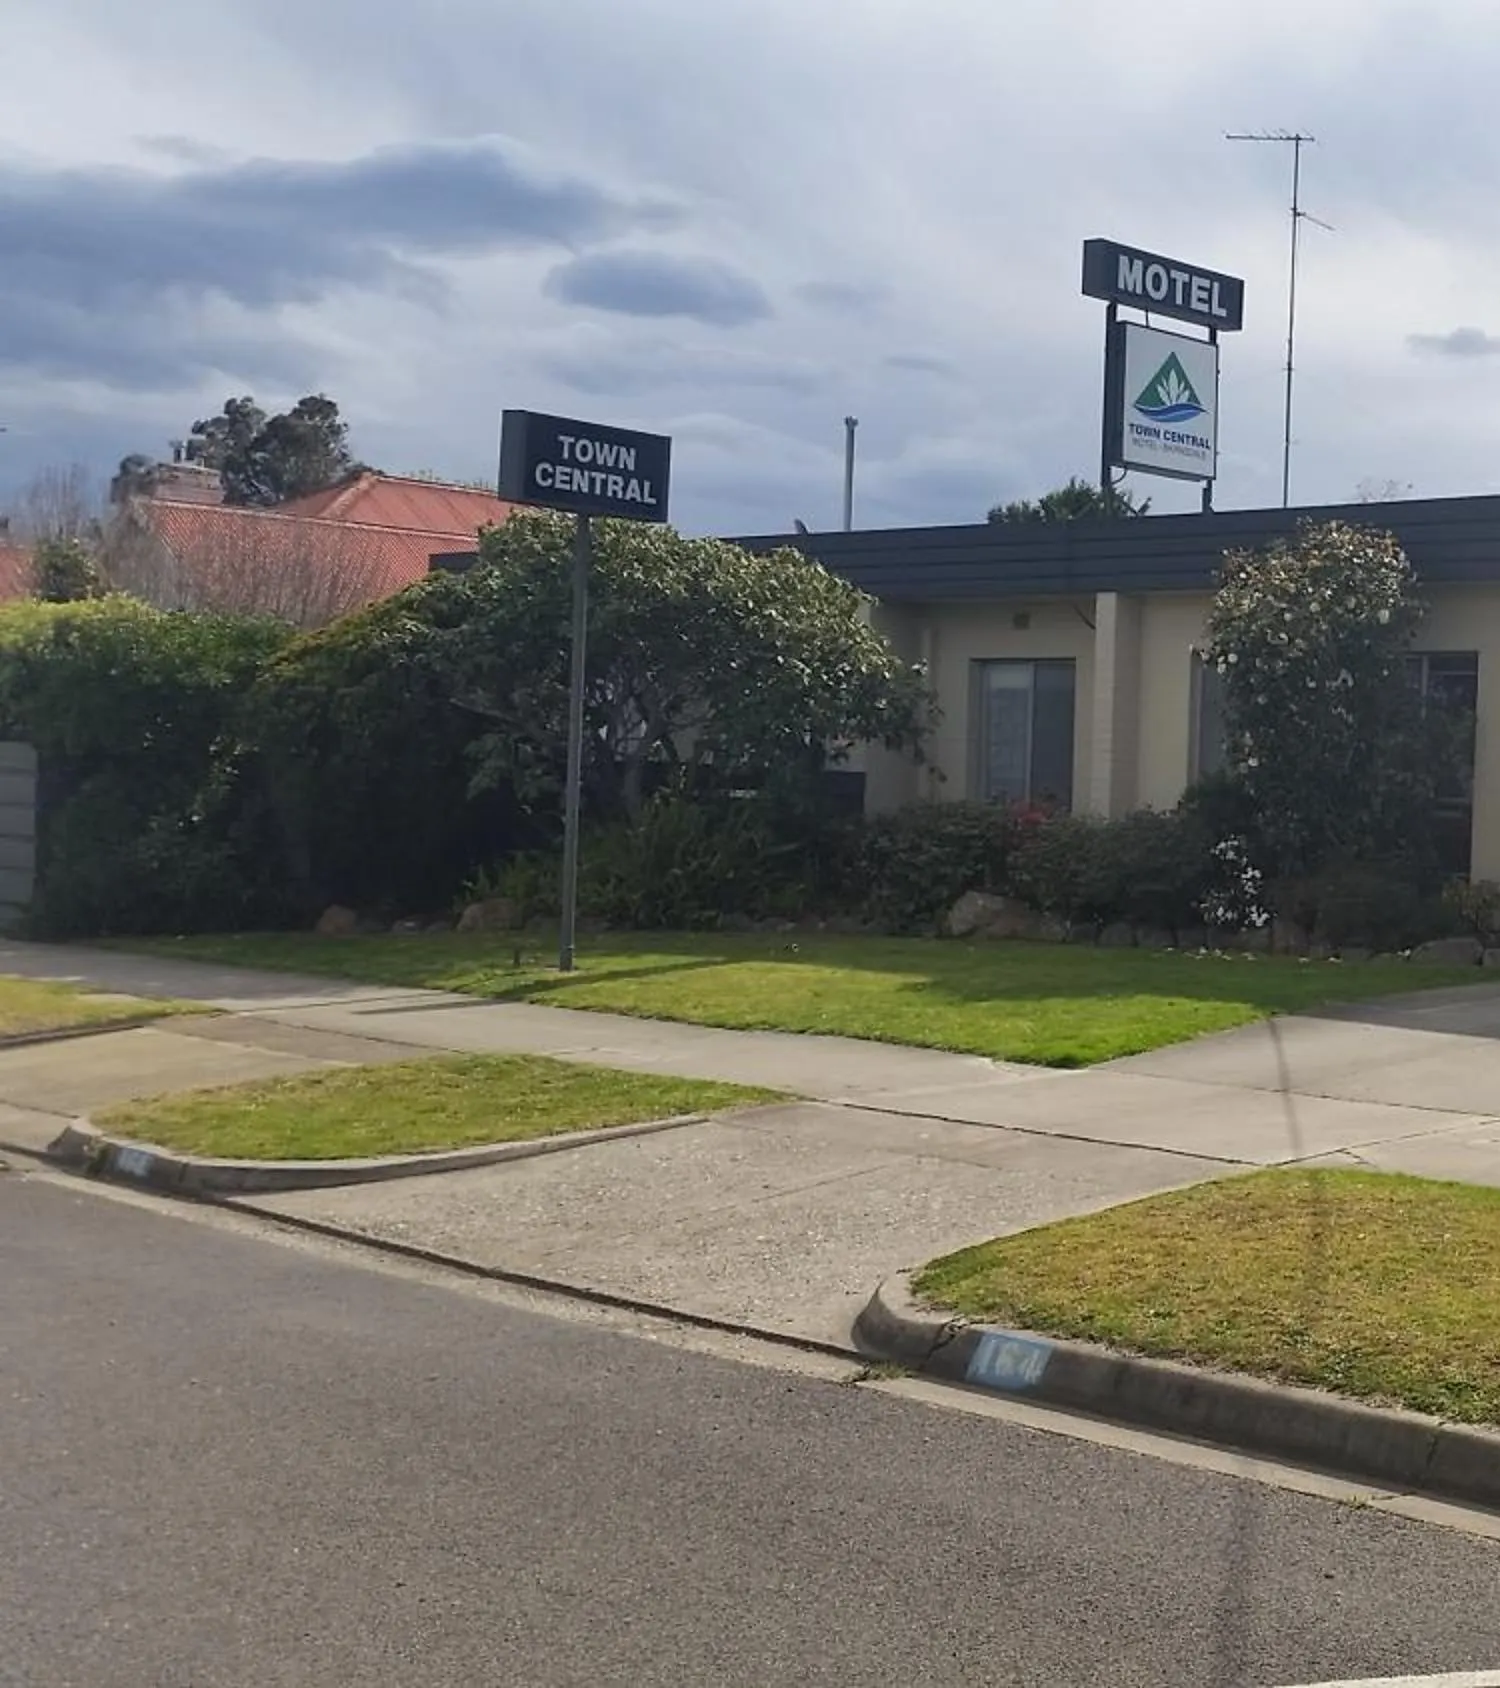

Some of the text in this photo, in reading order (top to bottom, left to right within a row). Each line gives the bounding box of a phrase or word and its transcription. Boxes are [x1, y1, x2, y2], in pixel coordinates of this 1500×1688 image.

[1118, 254, 1227, 317] MOTEL
[557, 435, 637, 471] TOWN
[1128, 423, 1210, 449] TOWN CENTRAL
[535, 462, 657, 505] CENTRAL
